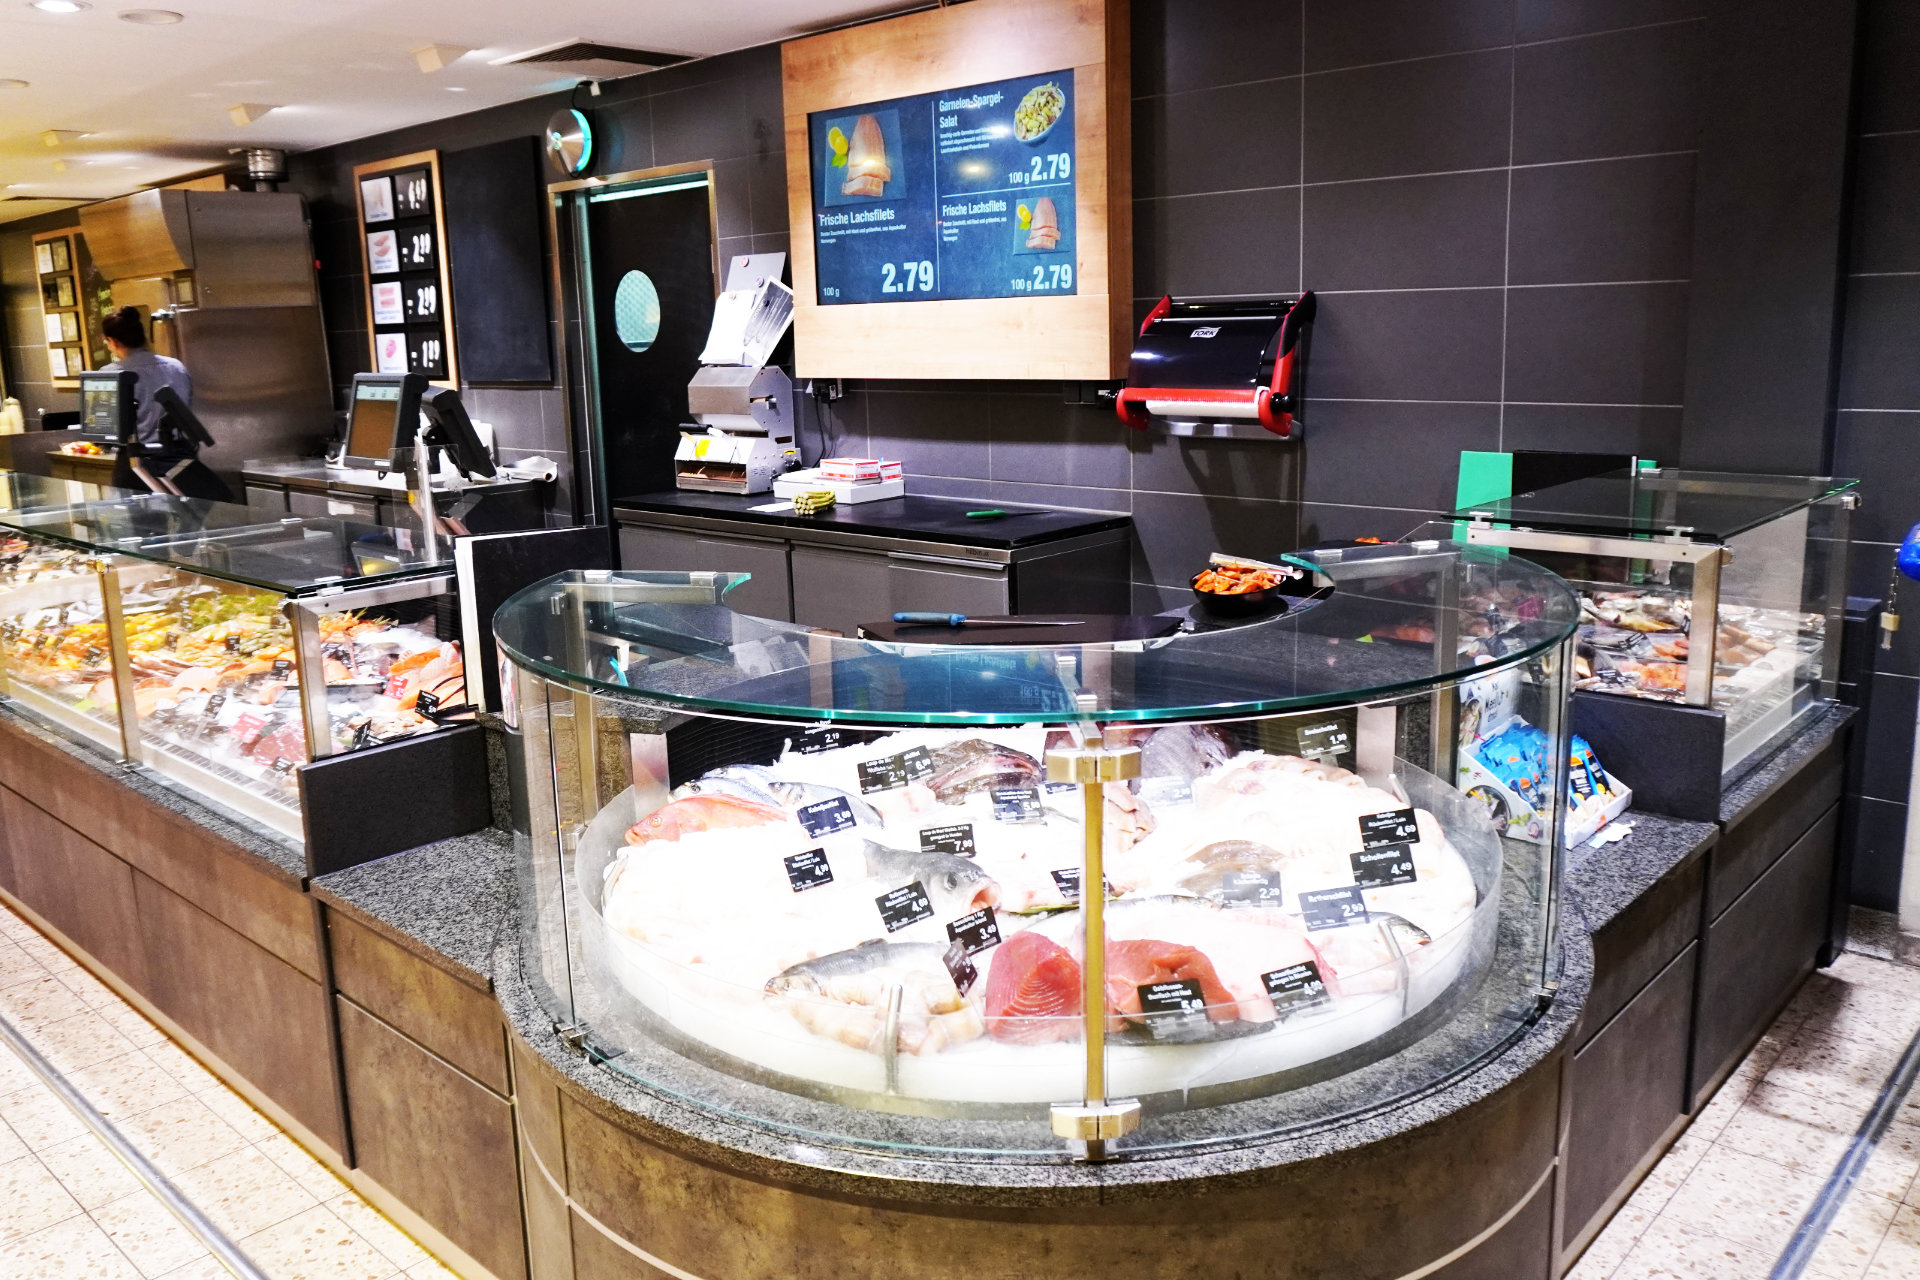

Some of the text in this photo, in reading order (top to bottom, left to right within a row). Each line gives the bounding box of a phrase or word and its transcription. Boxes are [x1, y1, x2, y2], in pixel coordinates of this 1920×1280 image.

[939, 91, 1004, 112] Garnelen-Spargel-
[940, 115, 958, 128] Salat
[1009, 153, 1070, 184] 100 g 2.79
[942, 200, 1006, 216] Frische Lachsfilets
[820, 208, 895, 226] Frische Lachsfilets
[882, 261, 934, 293] 2.79
[1011, 264, 1072, 291] 100 g 2.79
[823, 288, 840, 297] 100 g
[889, 770, 905, 781] 2.19
[1396, 825, 1416, 836] 4.69
[954, 839, 973, 851] 7.99
[1360, 850, 1400, 862] Schollenfilet
[1391, 862, 1412, 874] 4.49
[912, 897, 928, 912] 4.69
[980, 924, 996, 940] 3.49
[1181, 999, 1203, 1014] 5.49
